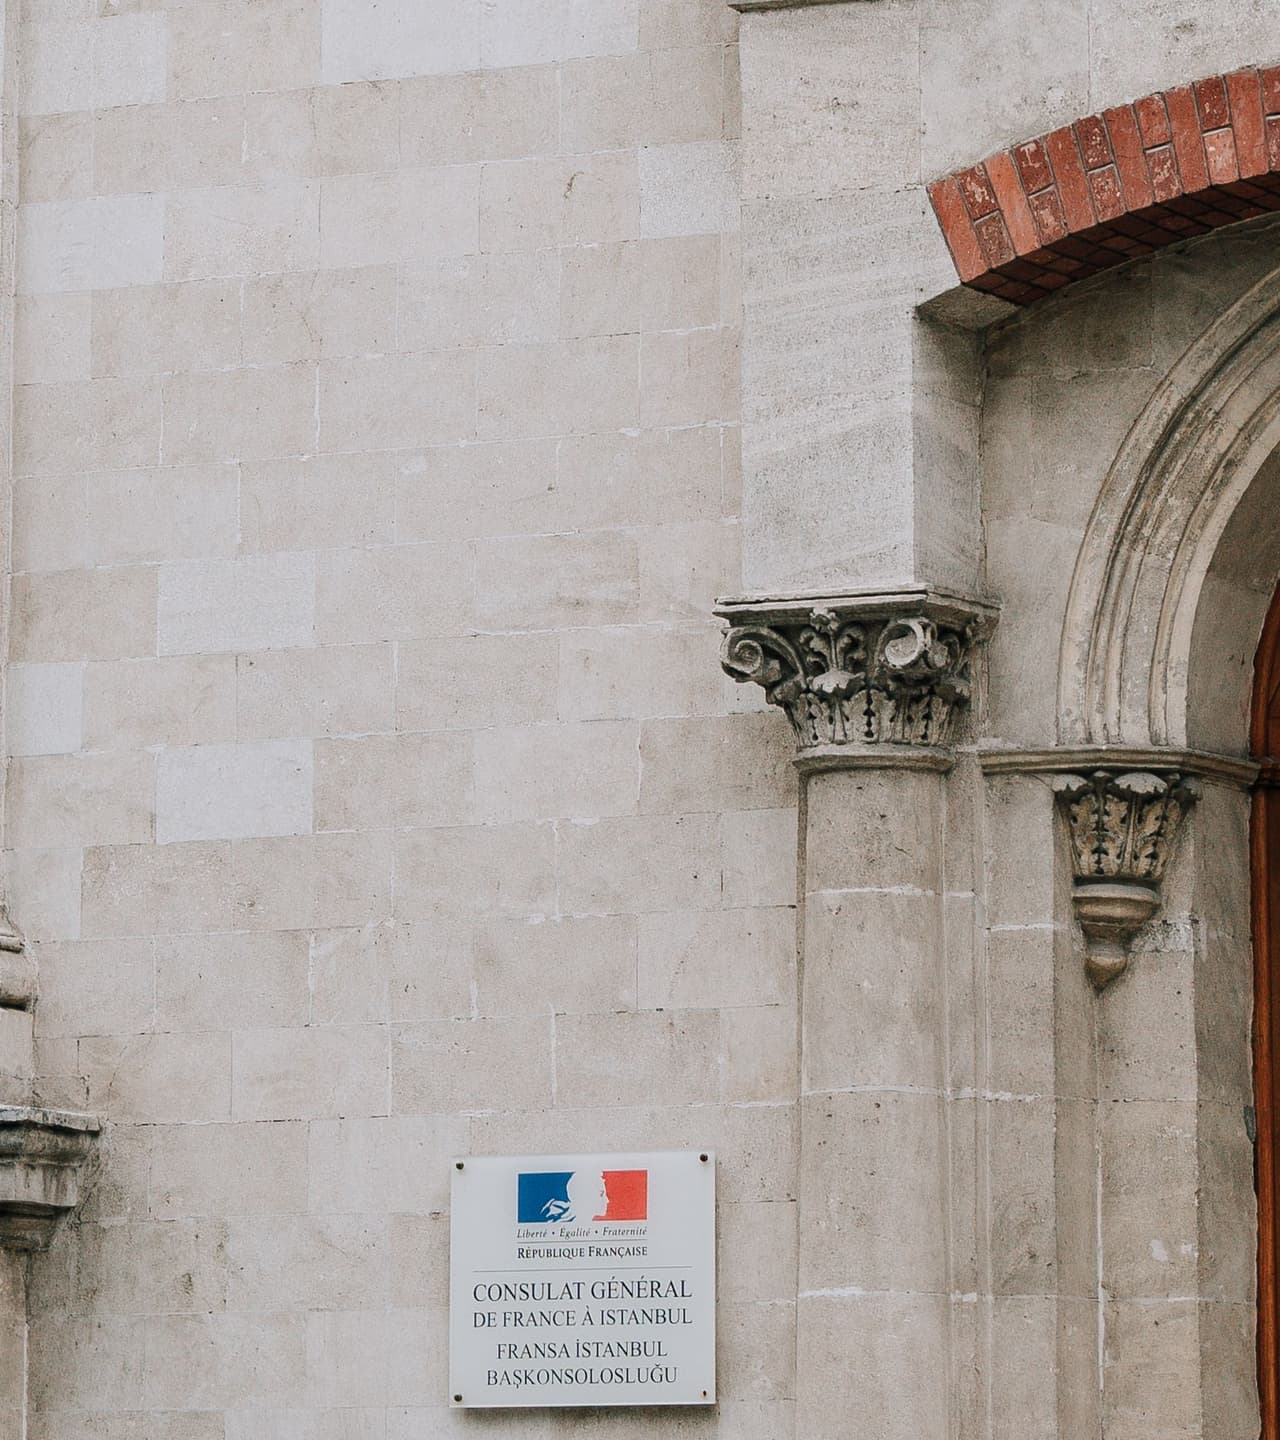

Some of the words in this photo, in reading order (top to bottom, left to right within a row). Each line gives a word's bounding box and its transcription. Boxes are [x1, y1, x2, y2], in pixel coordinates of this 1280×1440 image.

[517, 1228, 548, 1239] Liberté
[602, 1226, 647, 1236] Fraternité
[517, 1246, 585, 1260] RÉPUBLIQUE
[588, 1246, 648, 1258] FRANÇAISE
[473, 1282, 586, 1302] CONSULAT
[591, 1276, 692, 1300] GÉNÉRAL
[473, 1312, 497, 1328] DE
[503, 1310, 576, 1327] FRANCE
[581, 1306, 594, 1326] À
[600, 1308, 692, 1325] ISTANBUL
[497, 1342, 570, 1359] FRANSA
[576, 1339, 668, 1358] İSTANBUL
[487, 1364, 678, 1388] BAŞKONSOLOSLUĞU
